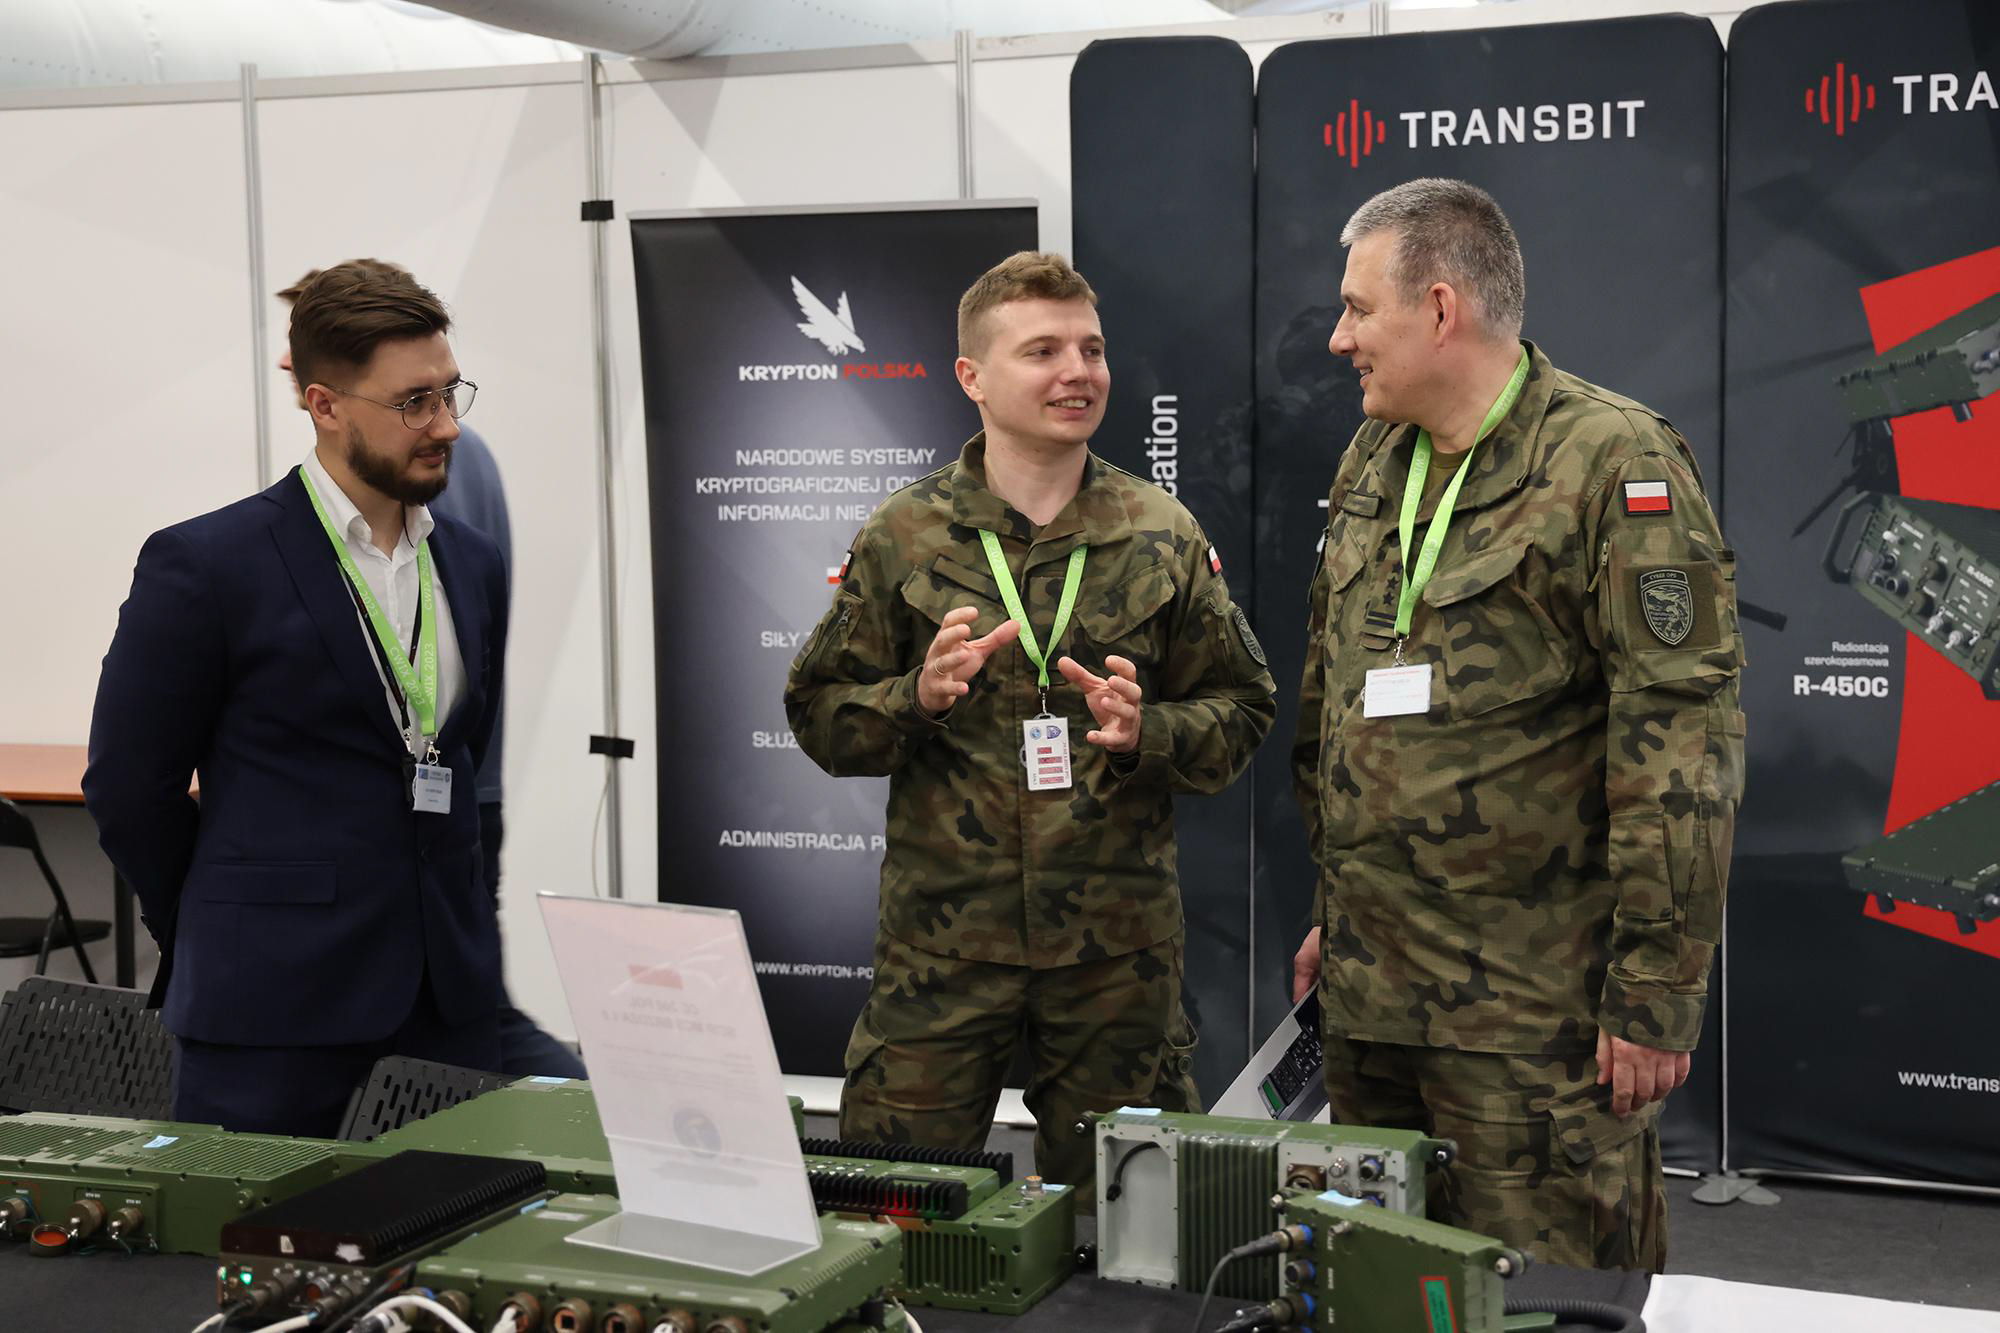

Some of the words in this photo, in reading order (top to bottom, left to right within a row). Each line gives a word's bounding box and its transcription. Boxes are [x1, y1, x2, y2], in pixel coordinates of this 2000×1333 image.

[1892, 70, 2000, 114] TRA
[1400, 99, 1645, 148] TRANSBIT
[738, 364, 838, 382] KRYPTON
[842, 363, 928, 380] POLSKA
[736, 449, 845, 467] NARODOWE
[850, 448, 937, 465] SYSTEMY
[695, 476, 881, 494] KRYPTOGRAFICZNEJ
[886, 476, 918, 492] OC
[718, 504, 830, 521] INFORMACJI
[340, 557, 363, 588] CWIX
[361, 590, 379, 618] 2023
[760, 630, 801, 648] SIŁY
[1831, 641, 1889, 655] Radiostacja
[424, 642, 434, 672] 2023
[1804, 656, 1889, 667] szerokopasmowa
[389, 647, 411, 678] CWIX
[407, 680, 425, 706] 2023
[1793, 674, 1889, 697] R-450C
[719, 829, 866, 852] ADMINISTRACJA
[1898, 1071, 1999, 1093] www.trans
